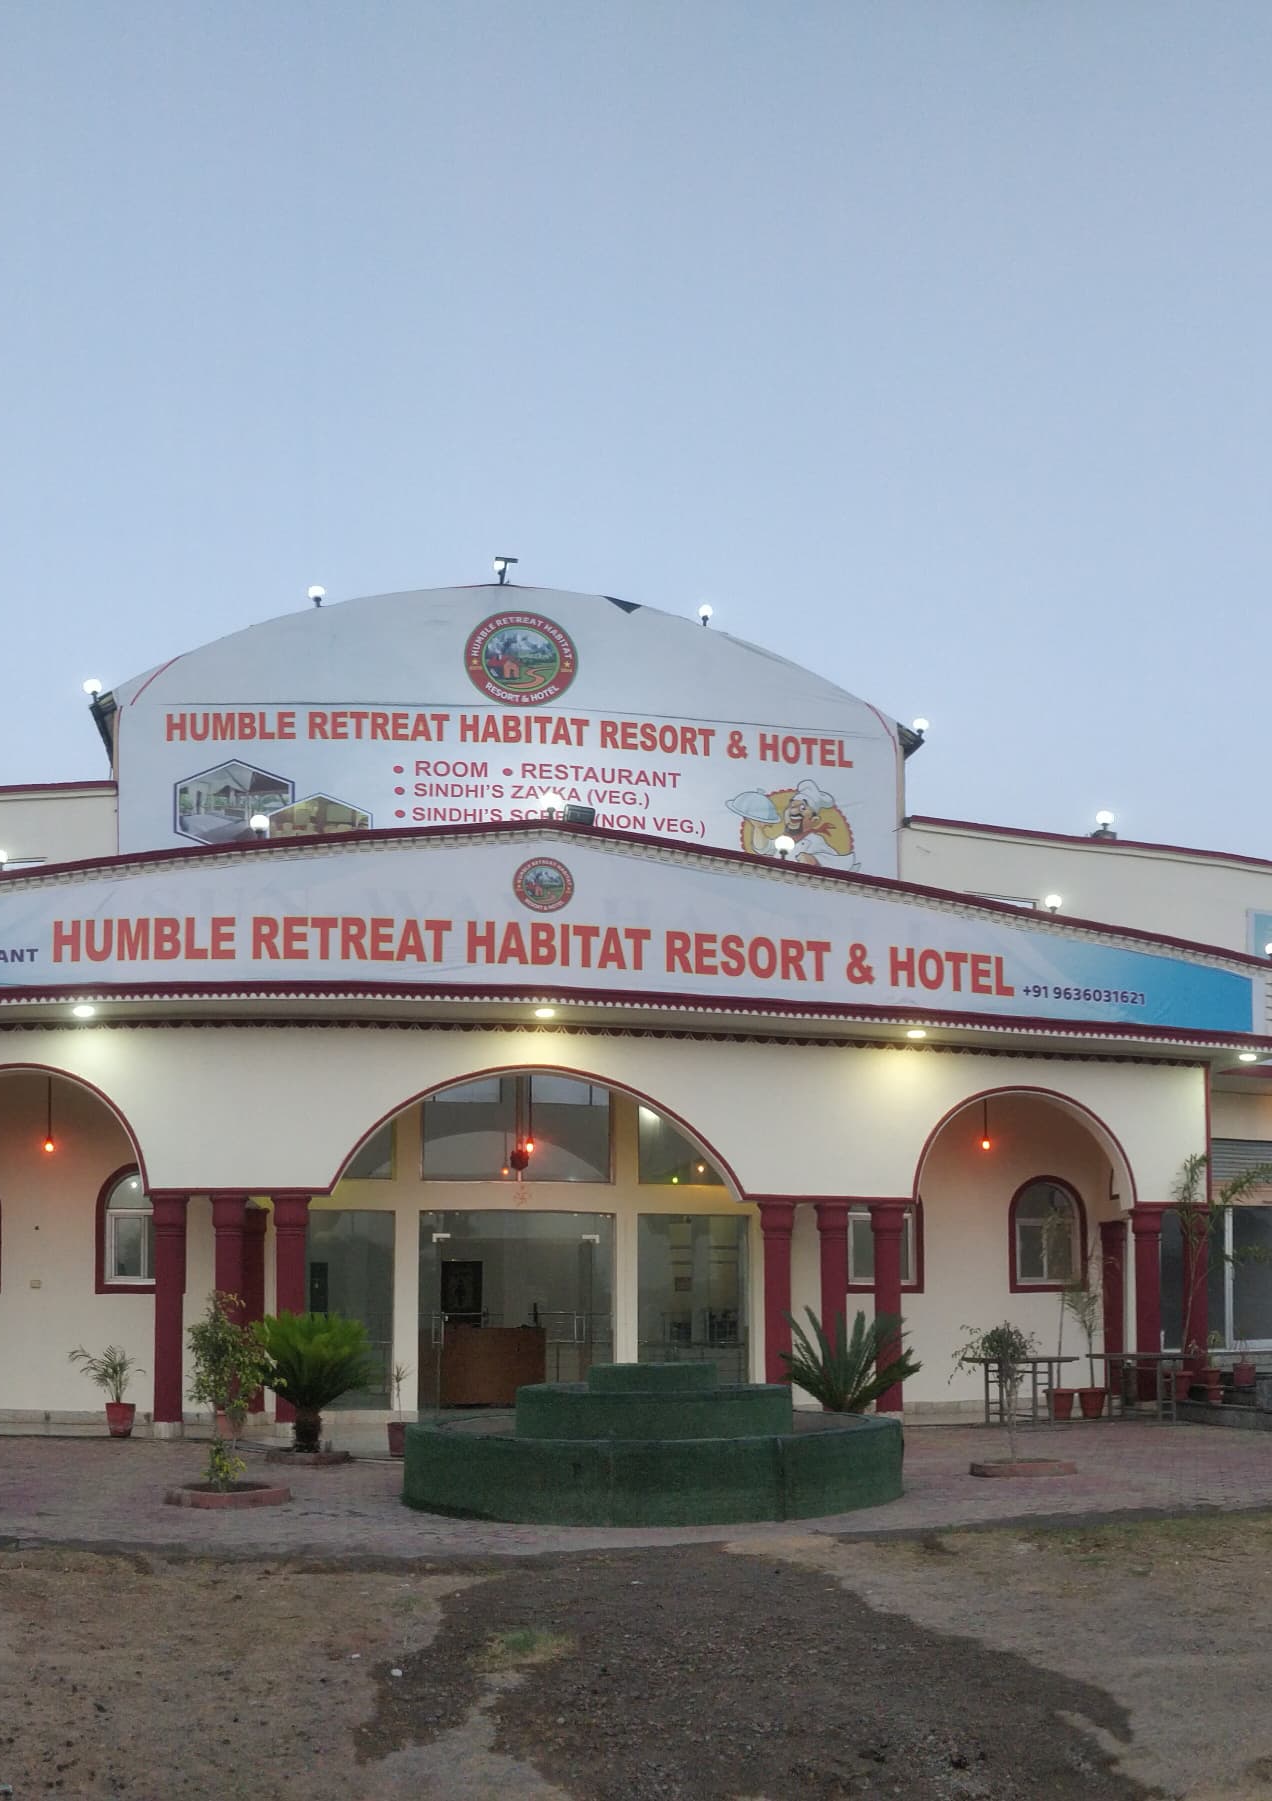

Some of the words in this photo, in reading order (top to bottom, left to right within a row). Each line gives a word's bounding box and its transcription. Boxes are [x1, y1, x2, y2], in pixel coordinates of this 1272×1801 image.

[471, 623, 496, 657] HUMBLE
[496, 616, 544, 627] RETREAT
[543, 624, 573, 659] HABITAT
[485, 682, 520, 702] RESORT
[530, 685, 560, 702] HOTEL
[165, 711, 296, 742] HUMBLE
[308, 711, 450, 742] RETREAT
[460, 714, 589, 747] HABITAT
[600, 720, 715, 757] RESORT
[726, 730, 748, 760] &
[759, 733, 854, 769] HOTEL
[414, 760, 488, 778] ROOM
[521, 763, 681, 789] RESTAURANT
[414, 783, 504, 799] SINDHI'S
[511, 785, 581, 802] ZAYKA
[587, 789, 650, 810] (VEG.)
[510, 809, 565, 823] SCRE
[594, 815, 649, 832] (NON
[653, 817, 705, 838] VEG.)
[51, 917, 236, 963] HUMBLE
[252, 917, 452, 962] RETREAT
[467, 921, 651, 972] HABITAT
[666, 930, 830, 983] RESORT
[846, 942, 876, 985] &
[889, 946, 1015, 997] HOTEL
[1022, 985, 1049, 999] +91
[1053, 987, 1146, 1006] 9636031621
